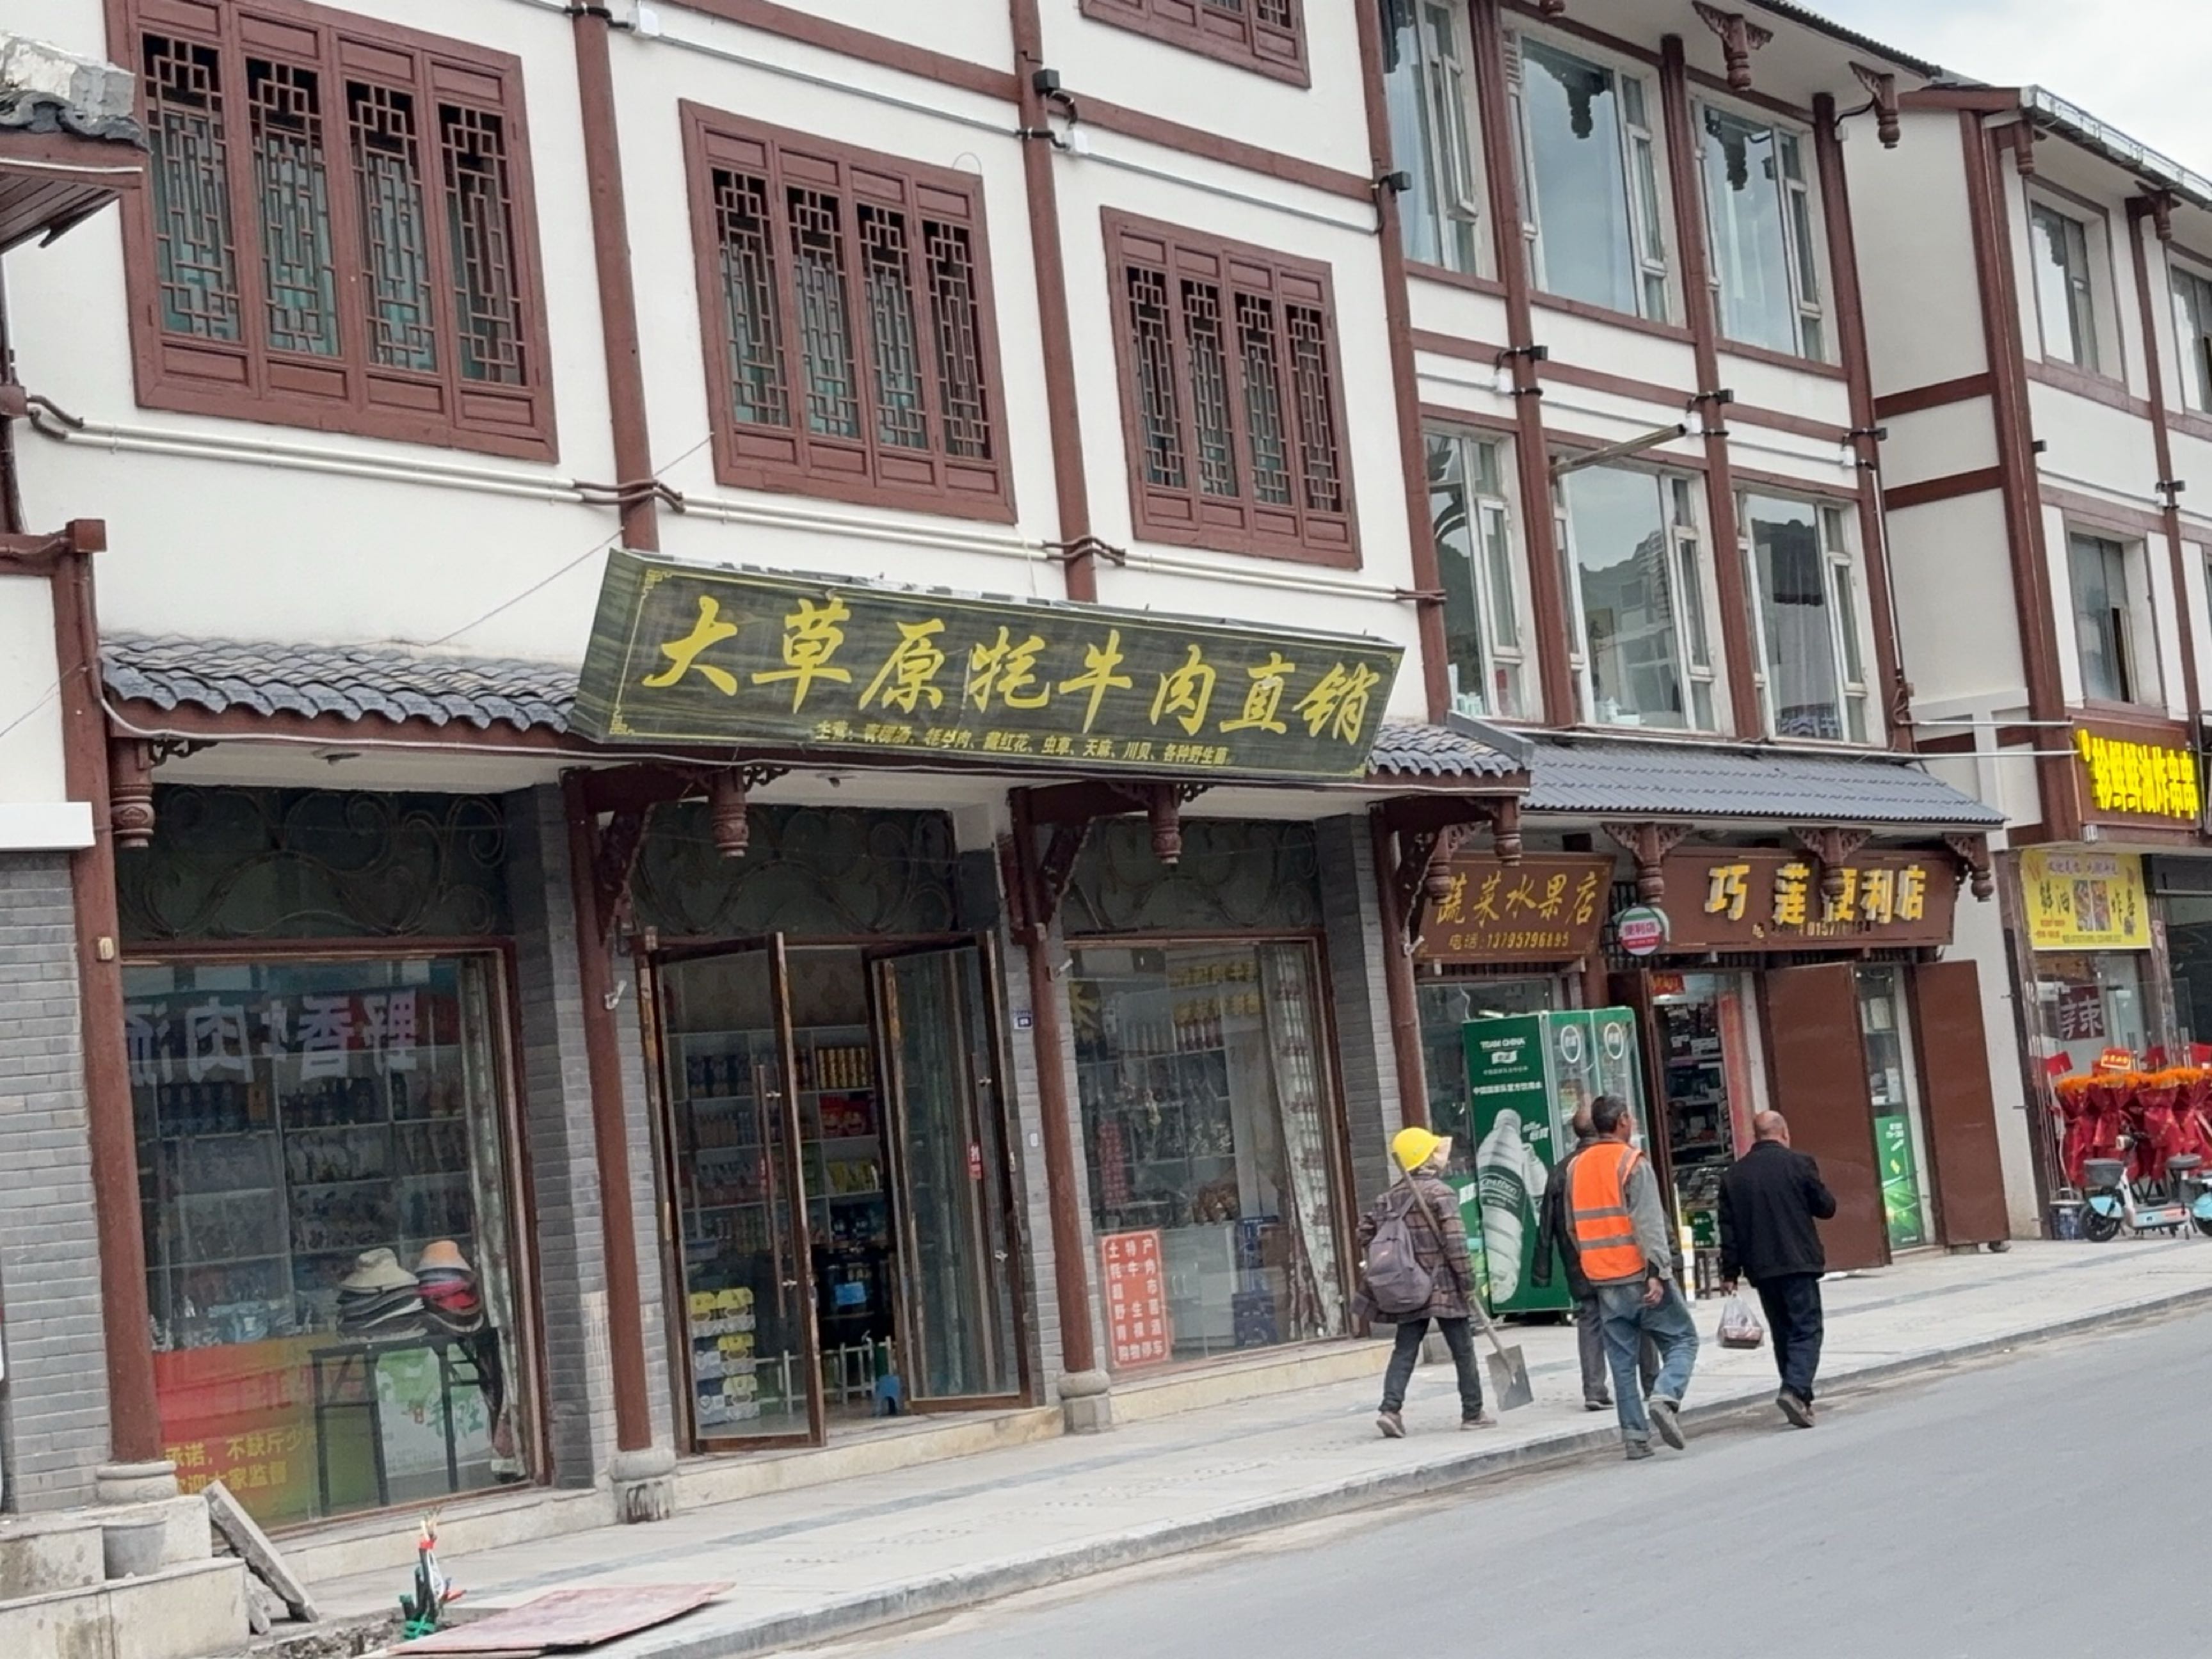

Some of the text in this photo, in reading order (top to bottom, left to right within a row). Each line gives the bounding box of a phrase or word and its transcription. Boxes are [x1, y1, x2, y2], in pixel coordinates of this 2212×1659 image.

[643, 597, 1380, 737] 大草原牦牛肉直销
[1436, 870, 1598, 927] 蔬菜水果店
